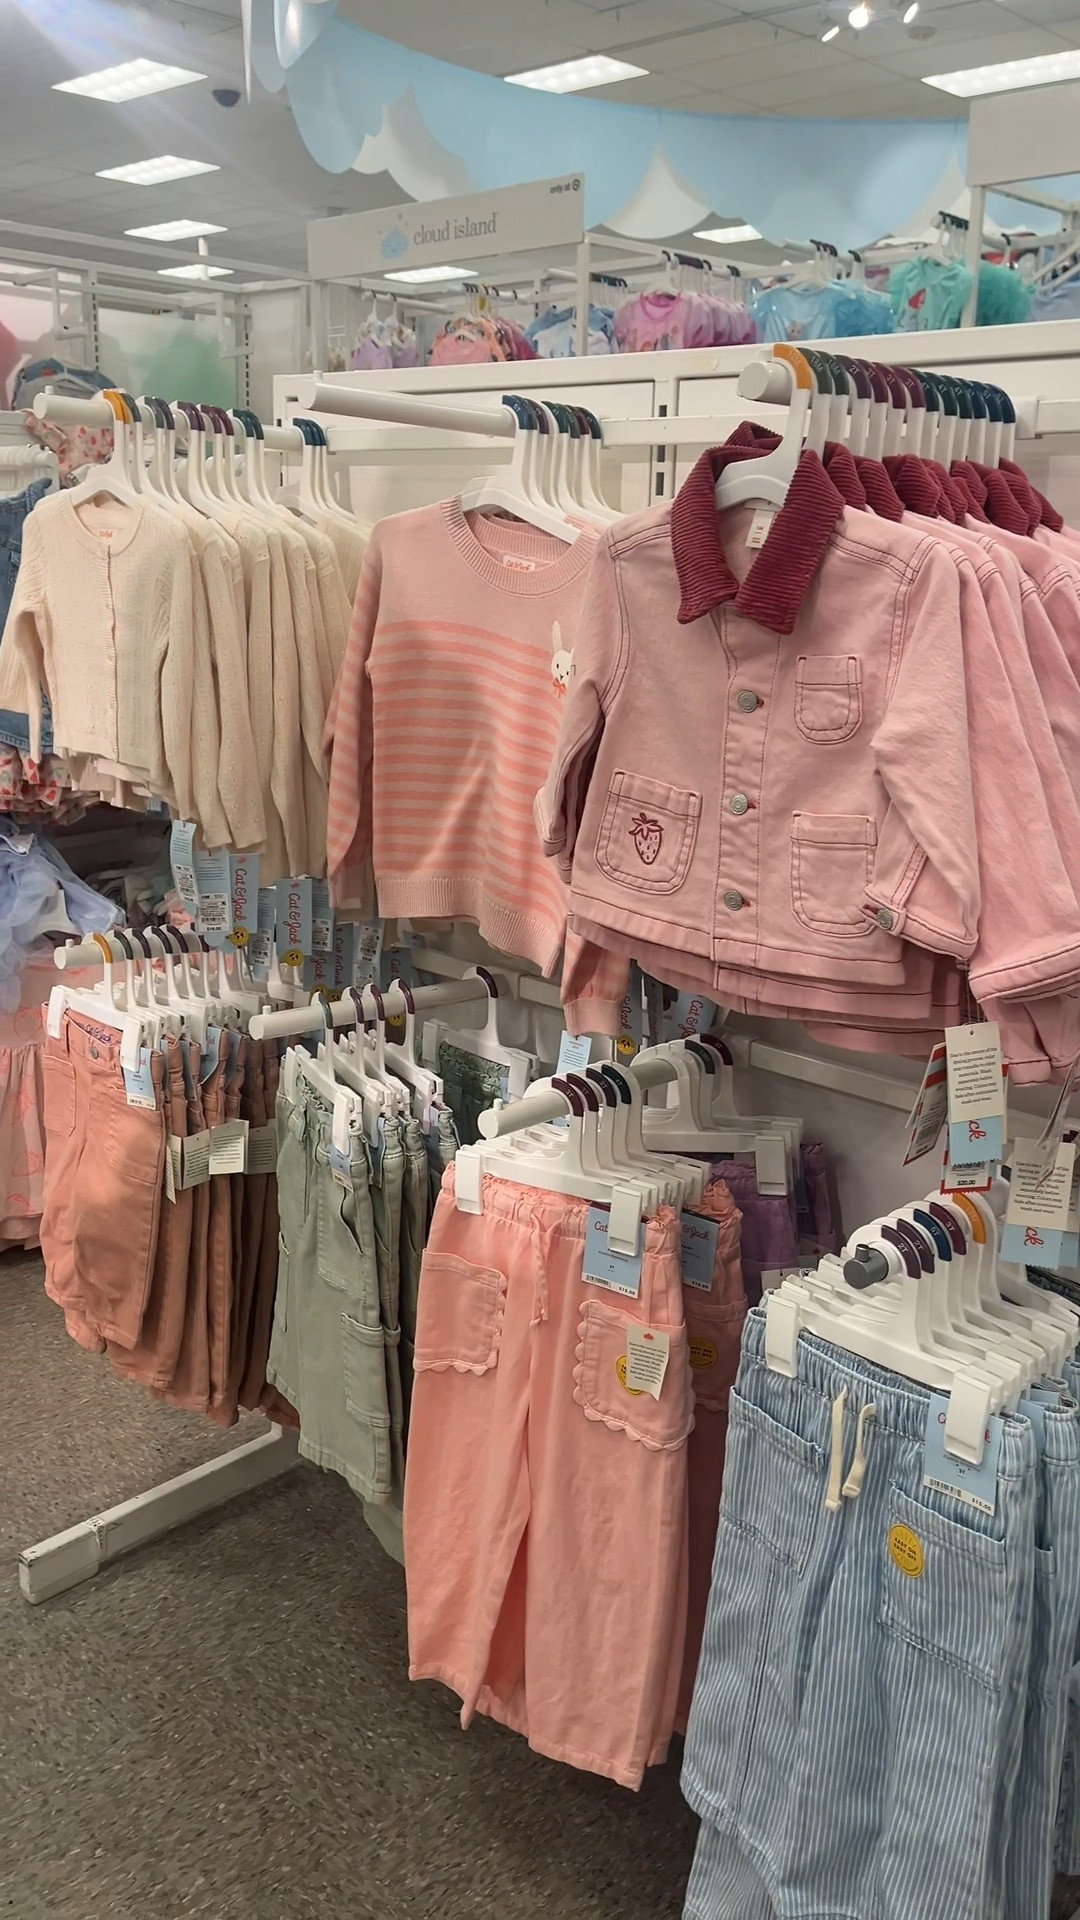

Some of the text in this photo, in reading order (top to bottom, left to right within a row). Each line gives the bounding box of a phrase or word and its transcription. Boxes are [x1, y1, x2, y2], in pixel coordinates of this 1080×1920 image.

[550, 184, 562, 194] only
[414, 212, 496, 246] cloud island
[812, 356, 824, 373] 18M
[849, 364, 860, 376] 2T
[886, 374, 896, 385] 3T
[904, 378, 916, 388] 3T
[231, 868, 248, 922] Cat & Jack
[283, 892, 302, 946] Cat & Jack
[311, 958, 326, 981] Jack
[688, 1000, 704, 1017] Cat
[686, 1016, 698, 1028] &
[600, 1080, 608, 1089] 2T
[566, 1089, 574, 1098] 3T
[968, 1119, 986, 1142] ck
[594, 1220, 609, 1233] Cat
[945, 1221, 956, 1231] 3T
[688, 1226, 710, 1240] Jack
[1024, 1226, 1044, 1246] ck
[898, 1243, 909, 1254] 2T
[914, 1240, 924, 1251] 2T
[894, 1542, 917, 1561] EASY OFF
[895, 1537, 917, 1556] EASY ON
